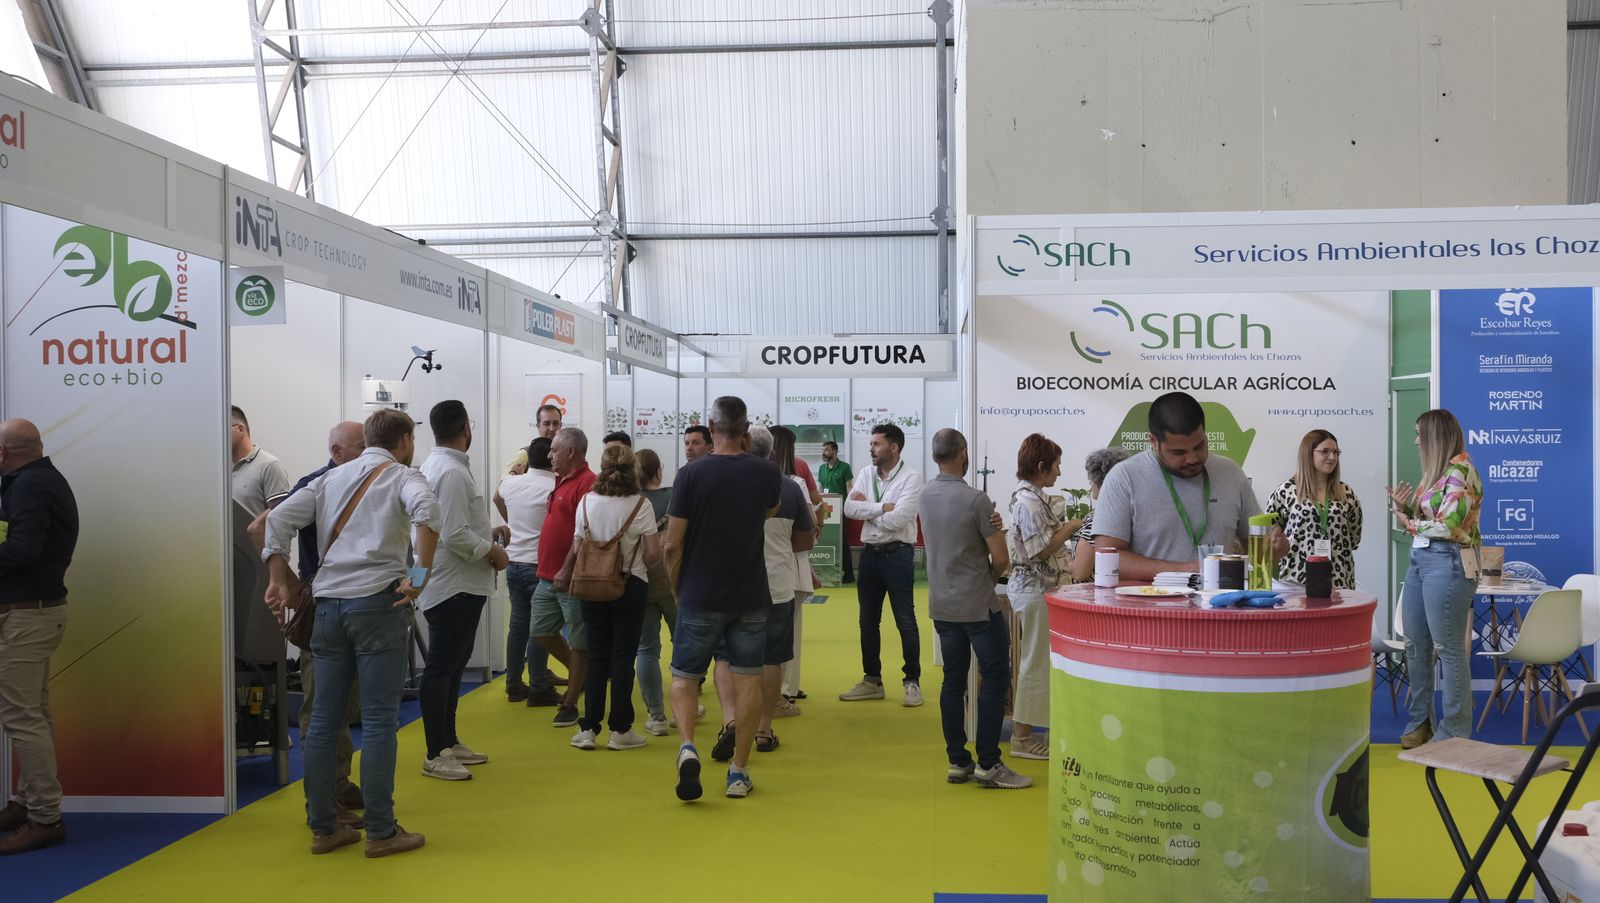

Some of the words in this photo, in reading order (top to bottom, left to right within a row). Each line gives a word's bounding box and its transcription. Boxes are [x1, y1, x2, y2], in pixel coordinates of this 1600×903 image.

[0, 110, 25, 150] al
[1044, 242, 1130, 266] SACh
[1194, 244, 1308, 264] Servicios
[1318, 240, 1481, 261] Ambientales
[1490, 238, 1526, 256] las
[1536, 236, 1600, 255] Choz
[286, 230, 309, 251] CROP
[314, 240, 368, 272] TECHNOLOGY
[400, 268, 453, 298] www.inta.com.es
[248, 298, 264, 306] eco
[1480, 318, 1522, 328] Escobar
[1523, 317, 1552, 330] Reyes
[1140, 312, 1272, 349] SACh
[42, 329, 187, 365] natural
[624, 324, 662, 359] CROPFUTURA
[761, 344, 926, 365] CROPFUTURA
[1140, 352, 1184, 361] Servicios
[1187, 352, 1248, 361] Ambientales
[1250, 352, 1264, 361] las
[1267, 352, 1302, 361] Chozas
[1480, 354, 1513, 365] Serafín
[1516, 354, 1552, 364] Miranda
[1016, 373, 1144, 390] BIOECONOMÍA
[1149, 376, 1237, 390] CIRCULAR
[1243, 373, 1336, 390] AGRÍCOLA
[980, 406, 1085, 417] info@gruposach.es
[1489, 400, 1542, 410] MARTIN
[1268, 408, 1374, 417] www.gruposach.es
[1121, 432, 1149, 440] PRODUC
[1205, 432, 1225, 441] ESTO
[1495, 434, 1561, 444] NAVASRUIZ
[1208, 442, 1229, 451] GETAL
[1489, 465, 1539, 478] Alcazar
[1505, 508, 1526, 521] FG
[1136, 782, 1154, 792] que
[1157, 784, 1190, 796] ayuda
[1193, 786, 1200, 795] a
[1136, 799, 1200, 814] metabólicos,
[1154, 818, 1182, 830] frente
[1193, 822, 1200, 830] a
[1079, 816, 1090, 826] de
[1169, 838, 1200, 848] Actúa
[1130, 853, 1135, 862] y
[1138, 852, 1200, 866] potenciador
